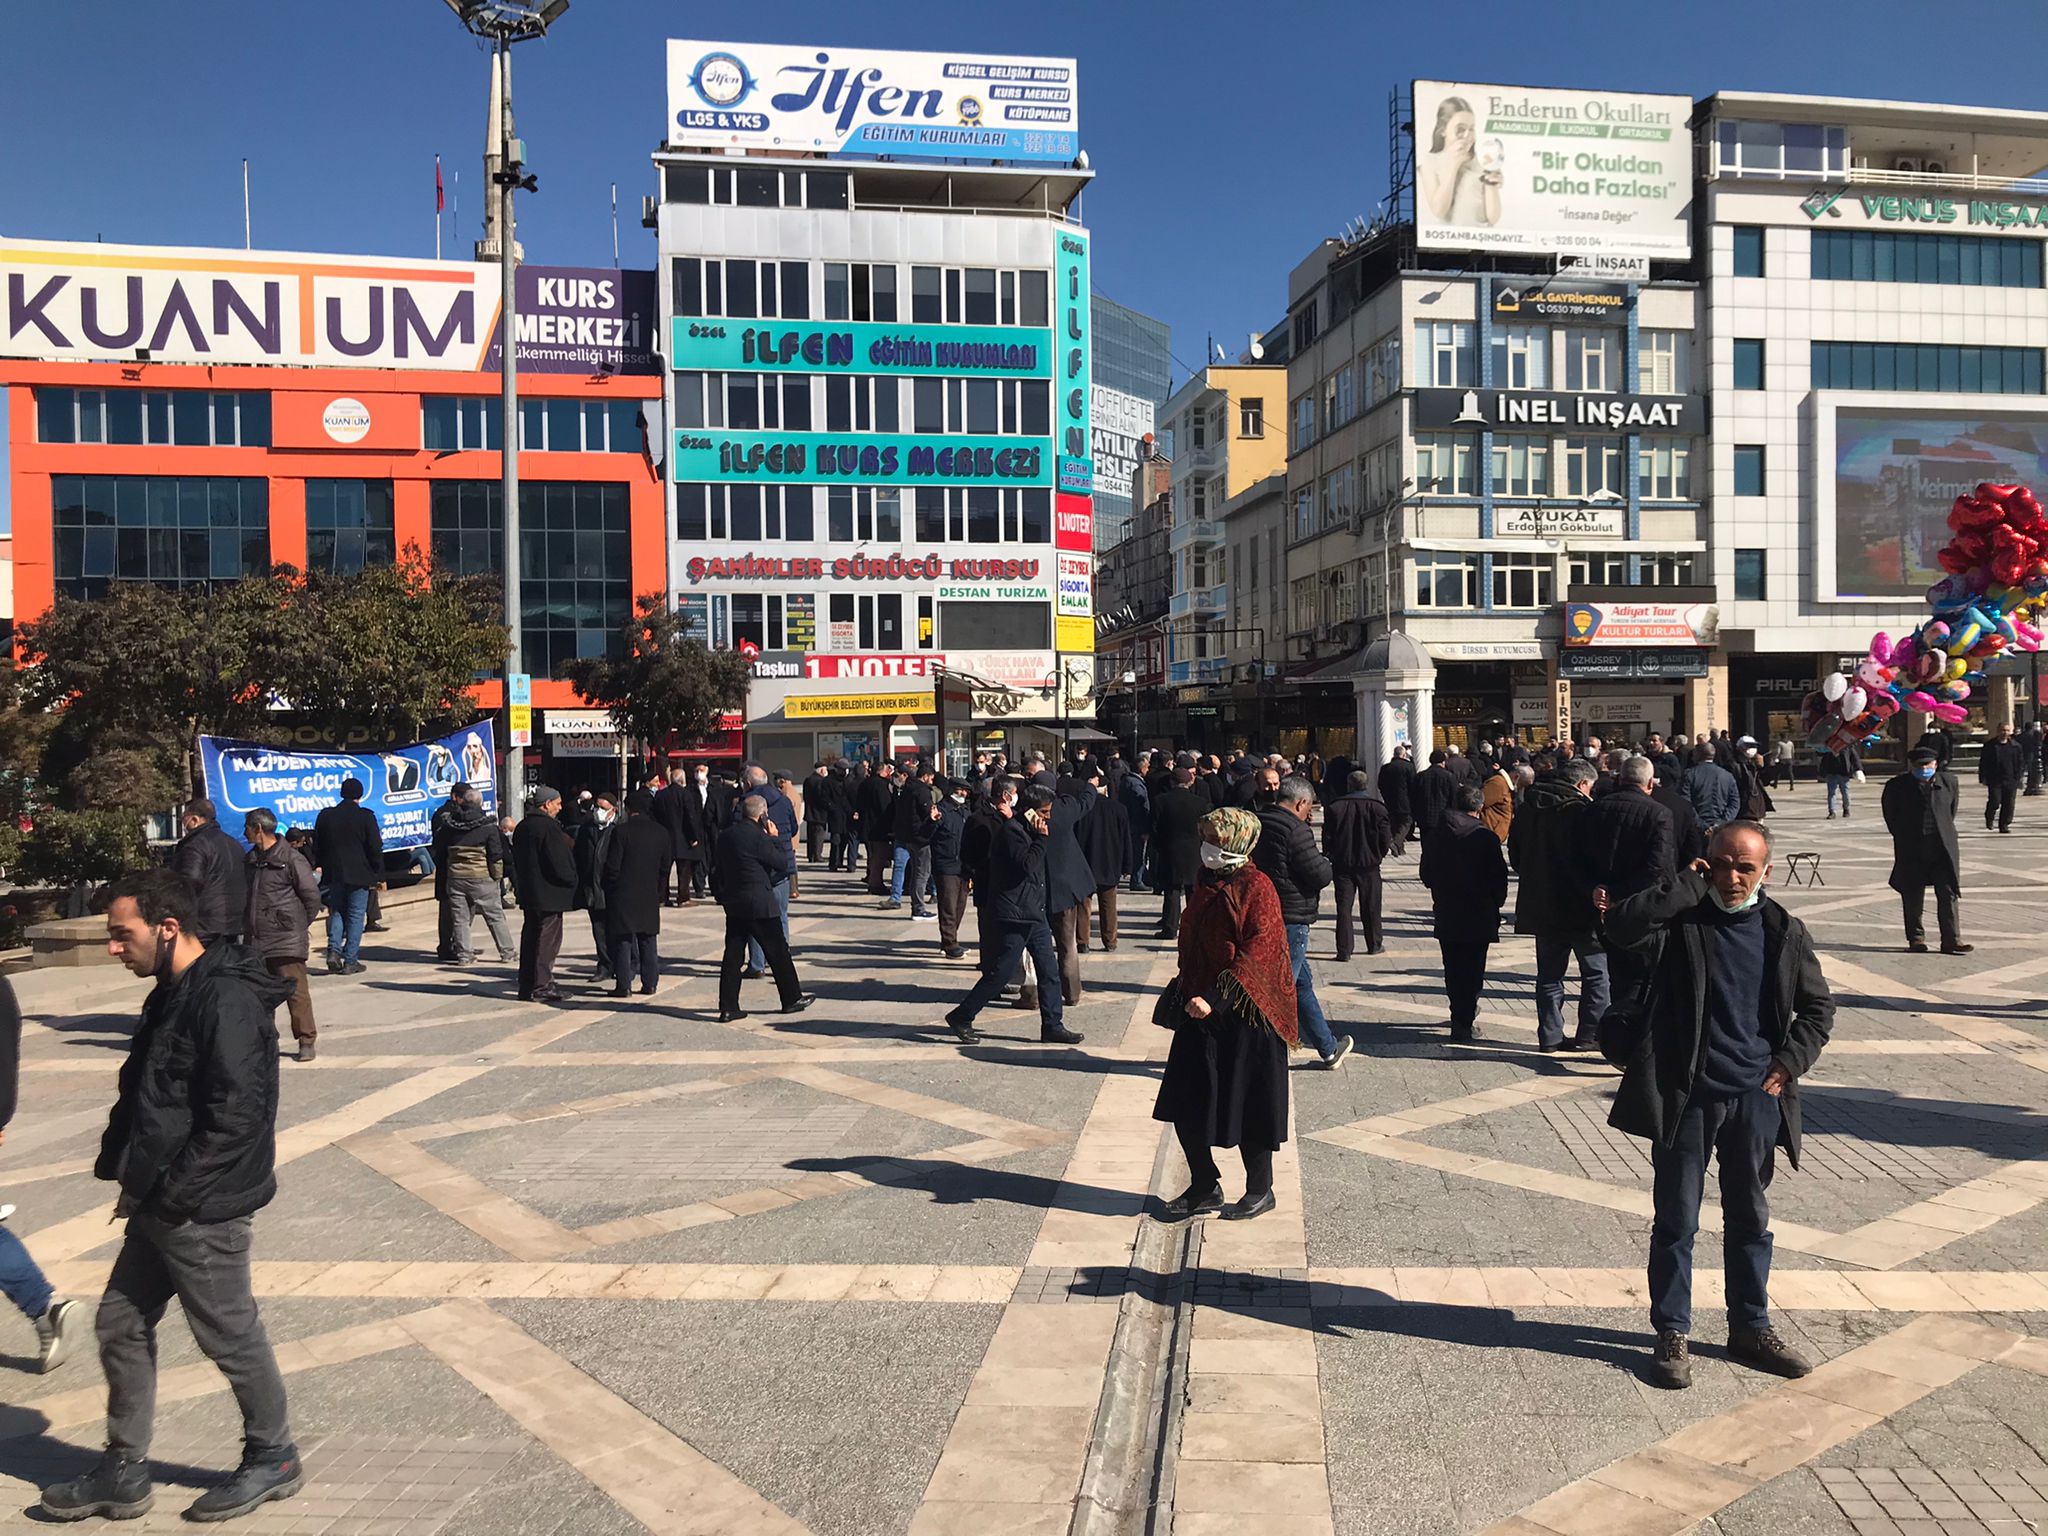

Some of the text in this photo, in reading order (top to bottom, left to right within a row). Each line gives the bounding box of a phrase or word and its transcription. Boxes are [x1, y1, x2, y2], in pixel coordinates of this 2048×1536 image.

[948, 63, 1069, 81] KİŞİSEL GELİŞİM KURSU
[771, 52, 944, 138] İlfen
[993, 86, 1069, 101] KURS MERKEZİ
[1008, 106, 1069, 121] KÜTÜPHANE
[1488, 96, 1671, 125] Enderun Okulları
[686, 111, 762, 129] LGS & YKS
[862, 124, 1008, 147] EĞİTİM KURUMLARI
[1491, 121, 1665, 141] ANAOKULU İLKOKUL ORTAOKUL
[1575, 153, 1663, 175] Okuldan
[1532, 176, 1590, 195] Daha
[1595, 255, 1645, 273] İNŞAAT
[537, 277, 616, 310] KURS
[1546, 291, 1624, 306] GAYRİMENKUL
[7, 256, 476, 359] KUANTUM
[1546, 304, 1569, 314] 0530
[1569, 306, 1584, 315] 789
[1584, 307, 1595, 315] 44
[515, 312, 640, 348] MERKEZİ
[493, 344, 604, 366] “ükemmelliği
[742, 327, 855, 366] İLFEN
[868, 335, 932, 368] EĞİTİM
[936, 339, 1037, 370] KURUMLARI
[1067, 265, 1085, 458] İLFEN
[1498, 393, 1684, 430] İNEL İNŞAAT
[324, 415, 370, 427] KUANTUM
[1091, 428, 1138, 461] ATILIK
[718, 440, 807, 475] İLFEN
[816, 444, 899, 478] KURS
[907, 444, 1041, 478] MERKEZİ
[1518, 510, 1600, 523] AVUKAT
[1560, 520, 1613, 535] Gökbulut
[687, 551, 1040, 585] ŞAHİNLER SÜRÜCÜ KURSU
[1068, 558, 1090, 577] ZEYBEK
[938, 584, 1048, 599] DESTAN TURİZM
[1059, 577, 1090, 595] SİGORTA
[1060, 594, 1089, 609] EMLAK
[1612, 605, 1677, 619] Adiyat Tour
[1643, 626, 1687, 637] TURLARI
[1492, 645, 1538, 655] KUYUMCUSU
[806, 658, 820, 679] 1
[977, 654, 1045, 668] TÜRK HAVA
[1570, 654, 1622, 666] ÖZHÜSREV
[754, 661, 799, 680] Taşkın
[986, 668, 1037, 679] YOLLARI
[800, 696, 920, 713] BÜYÜKŞEHİR BELEDİYESİ EKMEK BÜFESİ
[560, 739, 591, 749] KURS
[248, 776, 298, 794] HEDEF
[274, 794, 338, 814] TÜRKİYE
[382, 809, 423, 826] 25 ŞUBAT
